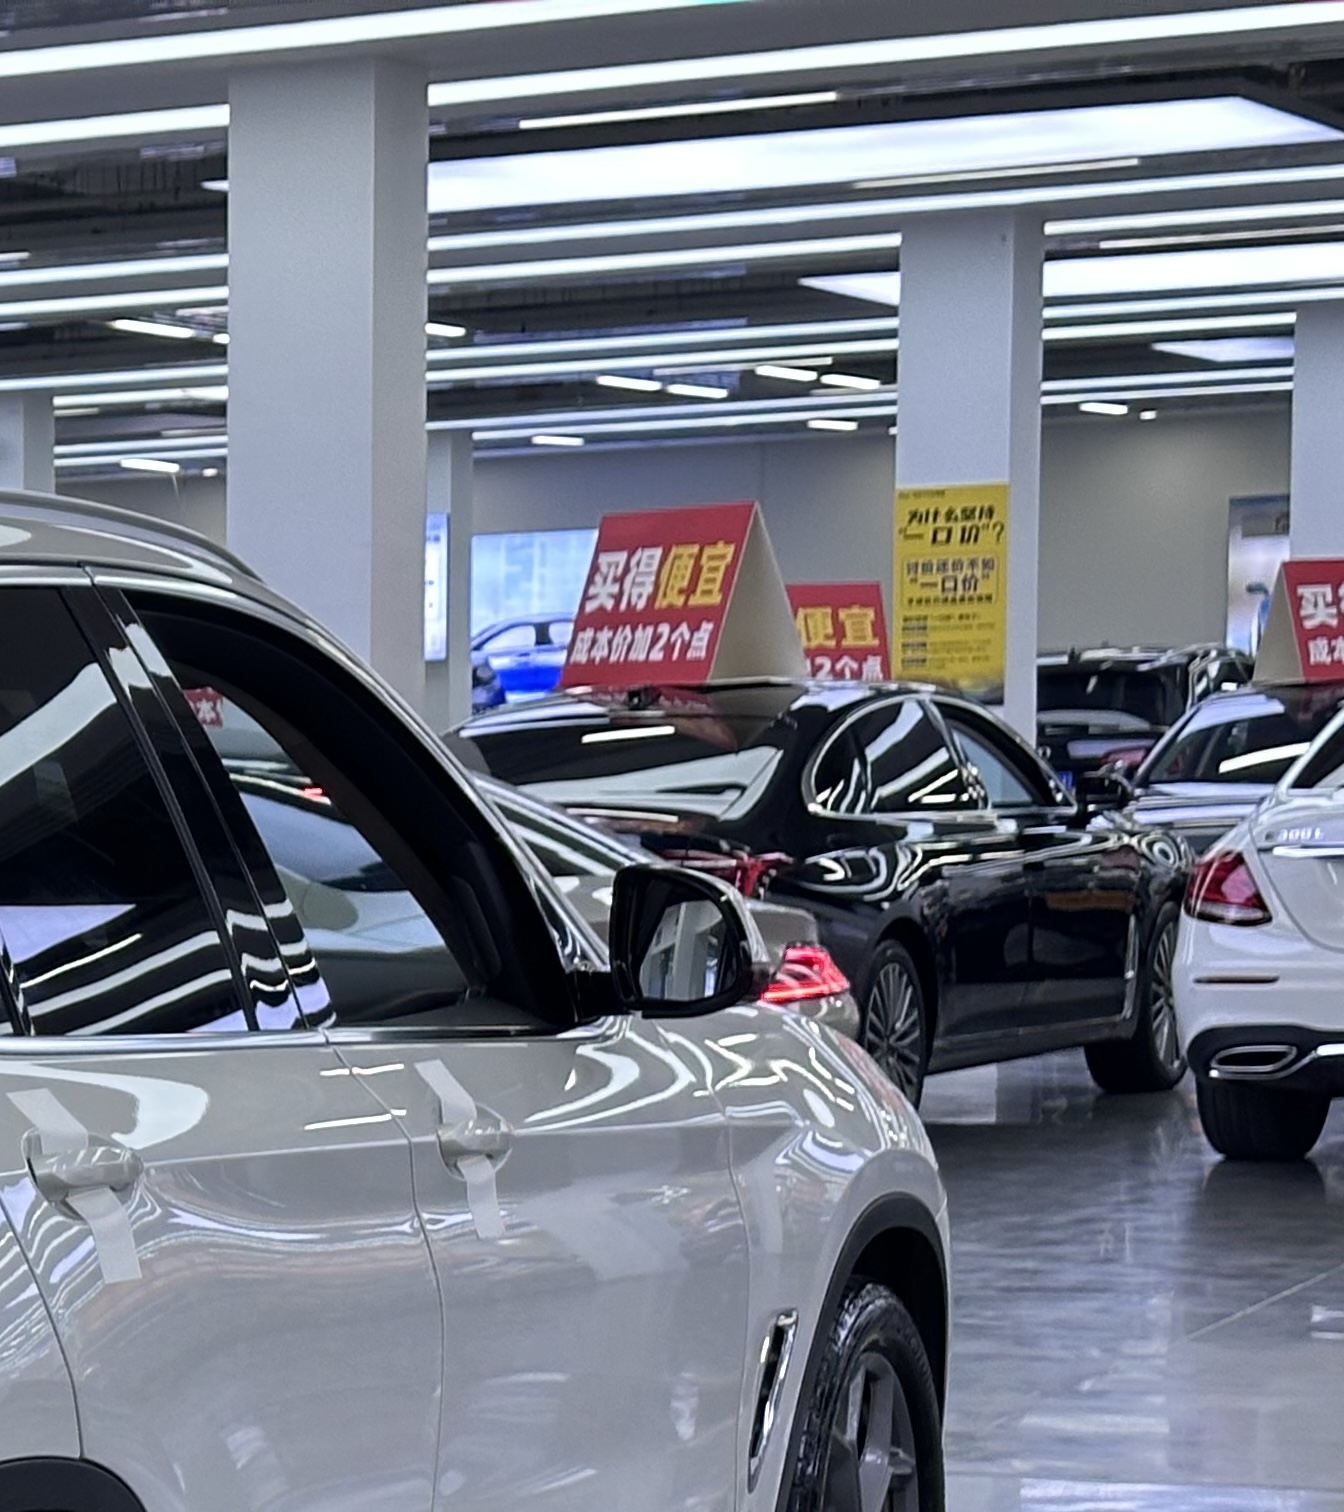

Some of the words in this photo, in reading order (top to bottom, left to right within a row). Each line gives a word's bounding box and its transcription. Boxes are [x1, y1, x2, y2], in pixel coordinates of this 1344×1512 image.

[585, 540, 736, 614] 买得便宜
[1296, 582, 1344, 630] 买
[569, 619, 714, 665] 成本价加2个点
